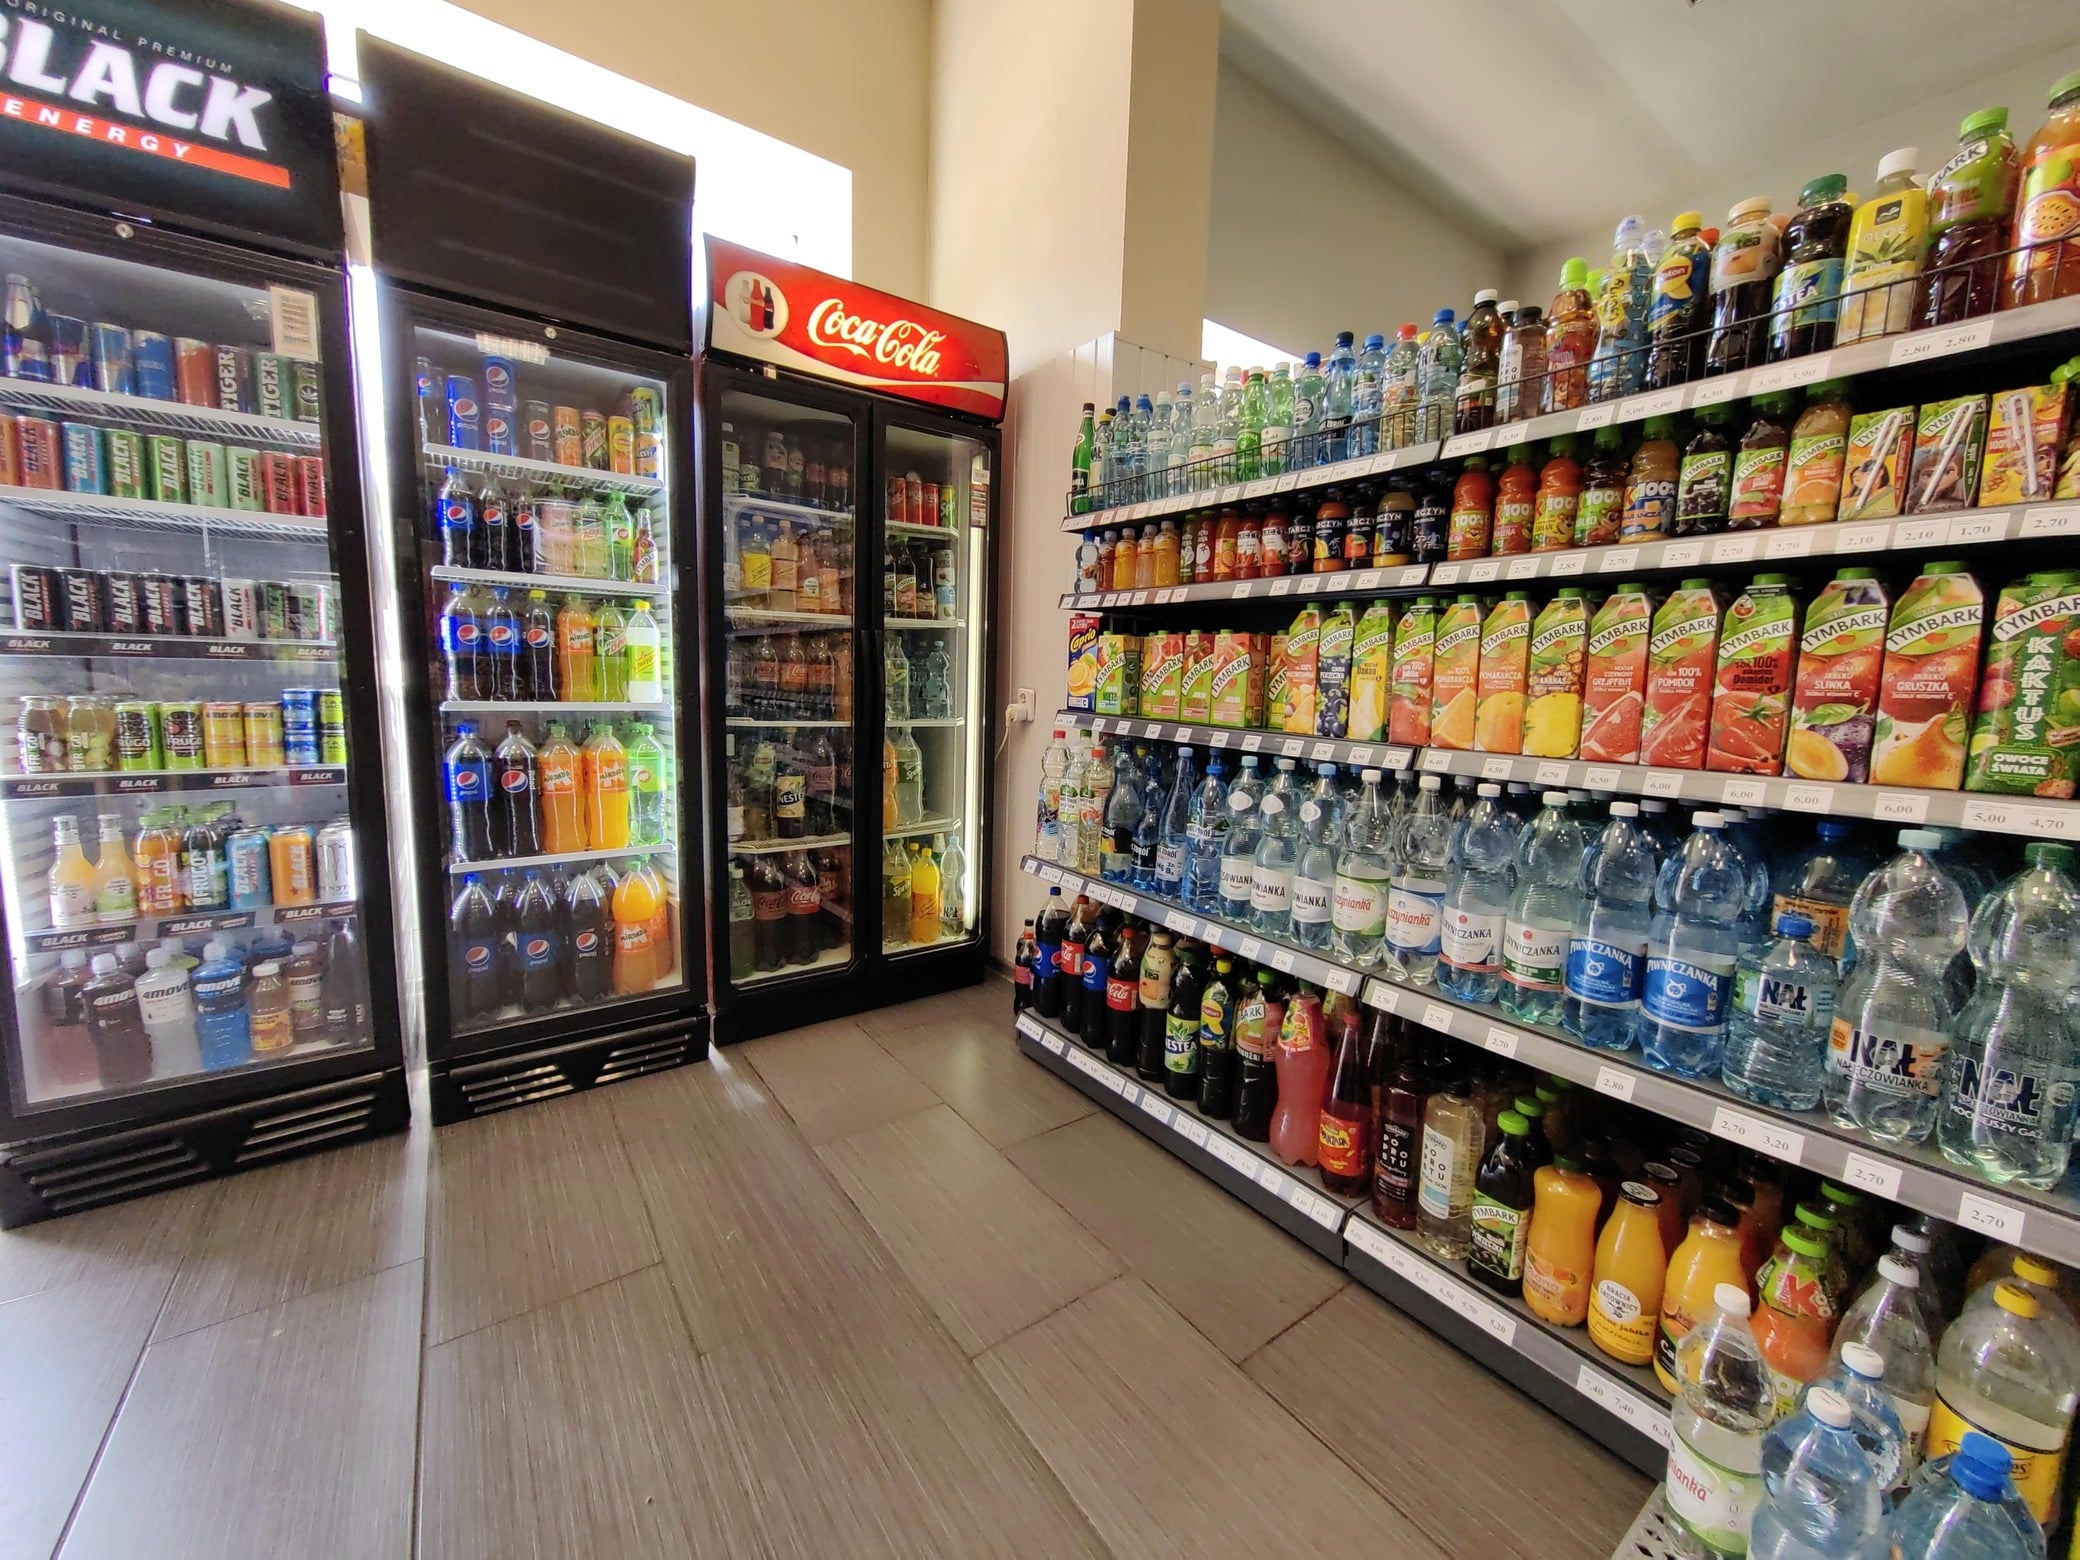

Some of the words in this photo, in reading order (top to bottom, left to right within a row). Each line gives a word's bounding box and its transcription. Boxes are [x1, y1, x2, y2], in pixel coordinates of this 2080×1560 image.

[137, 36, 234, 74] PREMIUM
[4, 98, 192, 159] ENERGY
[807, 297, 948, 378] Coca-Cola
[1740, 451, 1784, 476] TYMBARK
[1795, 438, 1843, 465] TYMBARK
[235, 455, 251, 498] BLACK
[1684, 455, 1725, 479] TYMBARK
[20, 572, 44, 621] BLACK
[67, 574, 92, 623] BLACK
[112, 577, 134, 624] BLACK
[144, 580, 164, 625] BLACK
[228, 586, 244, 628] BLACK
[1481, 624, 1529, 653] TYMBARK
[1532, 622, 1586, 651] TYMBARK
[1590, 619, 1649, 651] TYMBARK
[1650, 616, 1716, 651] TYMBARK
[1719, 620, 1791, 655] TYMBARK
[1802, 612, 1885, 651] TYMBARK
[1887, 606, 1980, 647] TYMBARK
[8, 639, 50, 648] BLACK
[112, 642, 152, 651] BLACK
[209, 645, 245, 654] BLACK
[1070, 626, 1097, 654] Caprio
[1353, 634, 1388, 657] TYMBARK
[1394, 634, 1433, 658] TYMBARK
[1435, 626, 1480, 653] TYMBARK
[297, 648, 331, 657] BLACK
[1150, 655, 1183, 692] TYMBARK
[1212, 655, 1250, 693] TYMBARK
[1657, 677, 1695, 688] POMIDOR
[1677, 667, 1703, 677] 100%
[1896, 681, 1949, 692] GRUSZKA
[2014, 635, 2057, 741] KAKTUS
[1990, 762, 2047, 777] ŚWIATA
[1993, 753, 2050, 765] OWOCE
[17, 783, 58, 791] BLACK
[119, 779, 158, 788] BLACK
[214, 775, 249, 784] BLACK
[301, 772, 333, 781] BLACK
[1884, 803, 1914, 815] 6.00
[1973, 812, 2007, 825] 5.00
[2029, 818, 2065, 831] 4.70
[286, 906, 324, 919] BLACK
[172, 918, 213, 932] BLACK
[42, 931, 88, 947] BLACK
[1144, 968, 1160, 981] tea
[1472, 1206, 1516, 1223] TYMBARK
